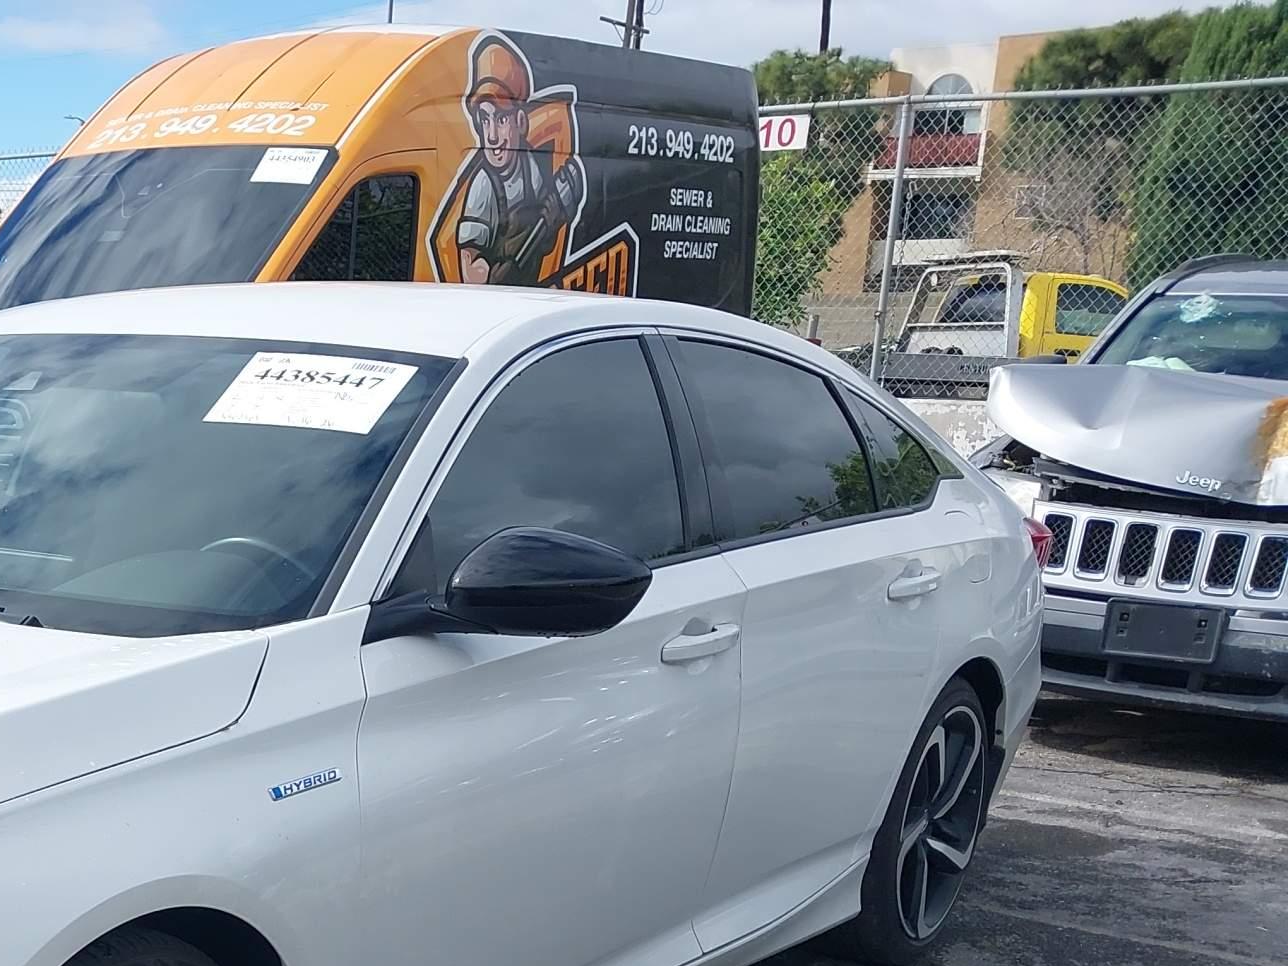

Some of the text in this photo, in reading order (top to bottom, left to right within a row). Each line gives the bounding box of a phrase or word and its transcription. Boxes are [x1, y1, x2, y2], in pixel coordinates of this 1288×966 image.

[760, 118, 796, 148] 10
[670, 188, 713, 208] SEWER &
[651, 213, 731, 235] DRAIN CLEANING
[663, 240, 718, 260] SPECIALIST
[254, 368, 385, 390] 44385447
[1175, 470, 1222, 492] Jeep
[283, 770, 337, 795] HYBRID
